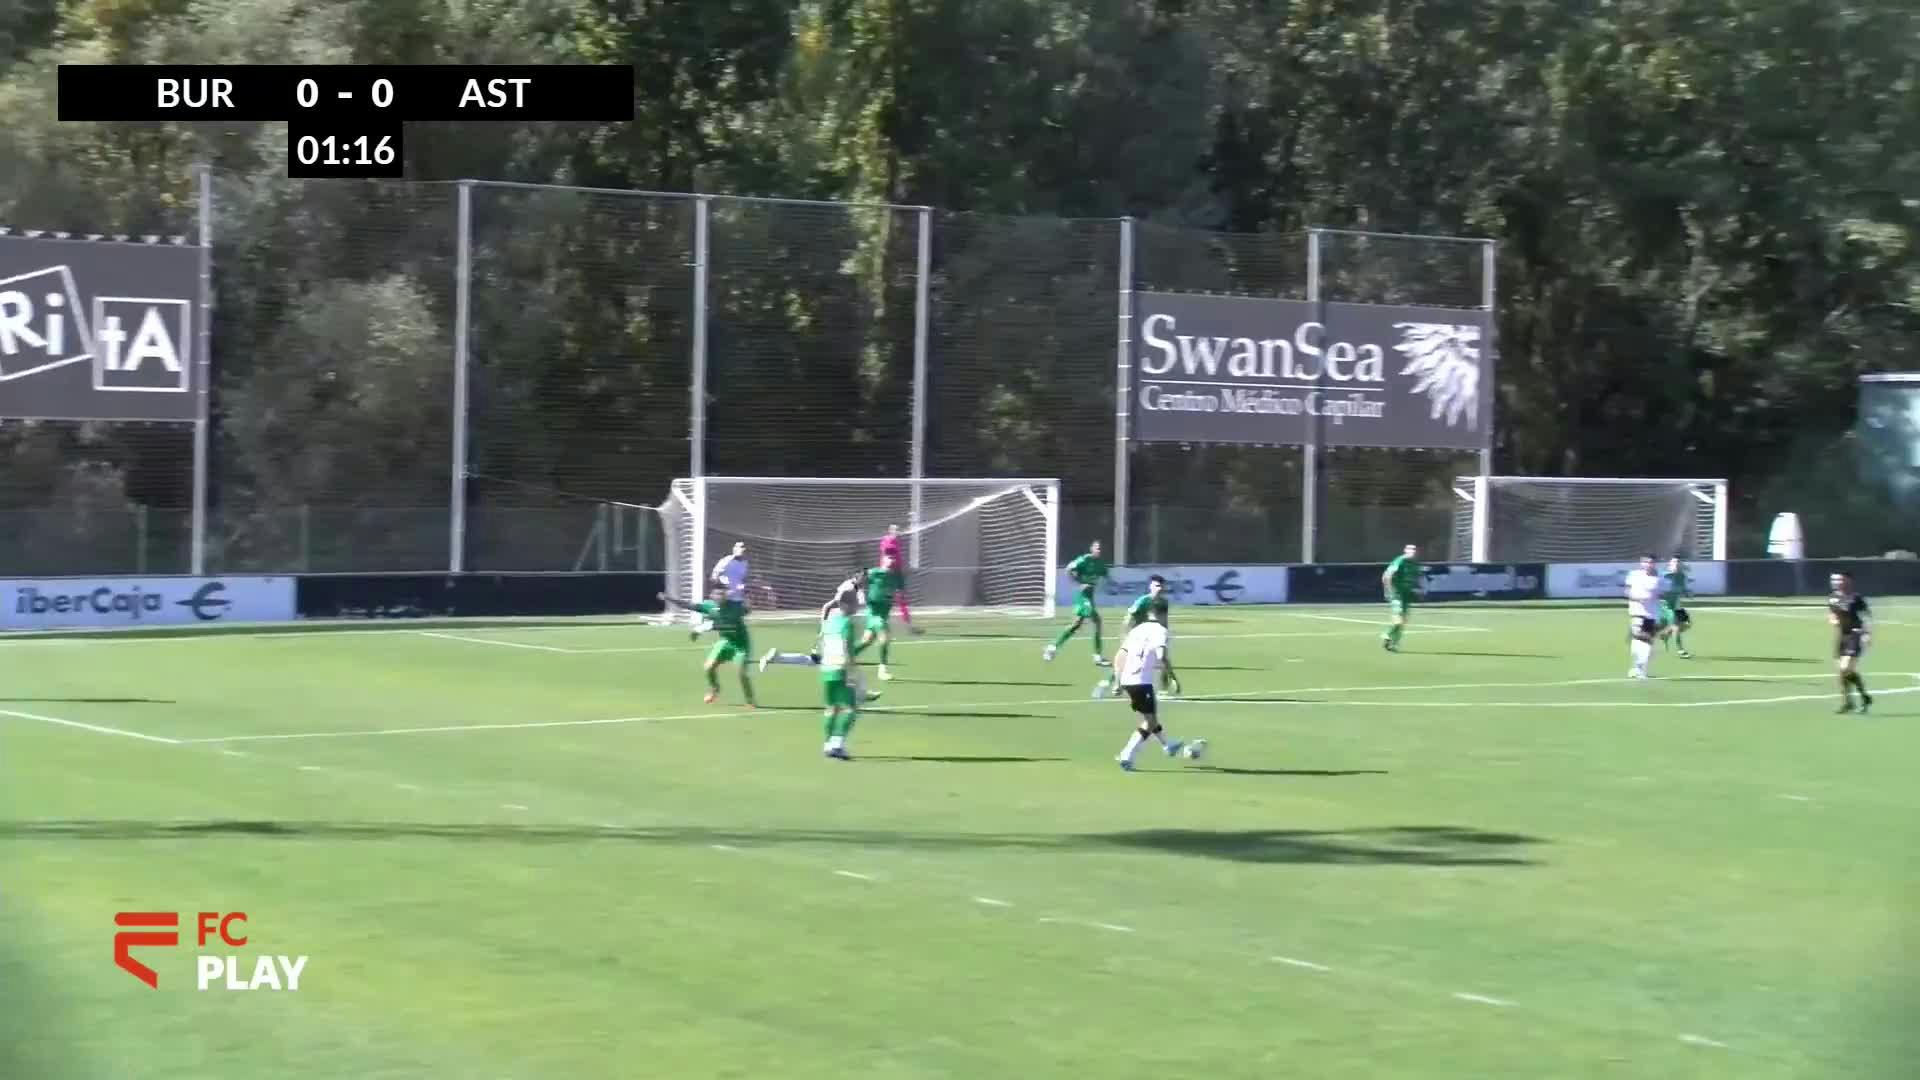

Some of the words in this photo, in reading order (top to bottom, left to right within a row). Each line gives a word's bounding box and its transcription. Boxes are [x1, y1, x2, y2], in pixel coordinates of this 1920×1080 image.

[1141, 314, 1385, 382] SwanSea
[1139, 385, 1218, 412] Centro
[1305, 391, 1386, 425] Capilar
